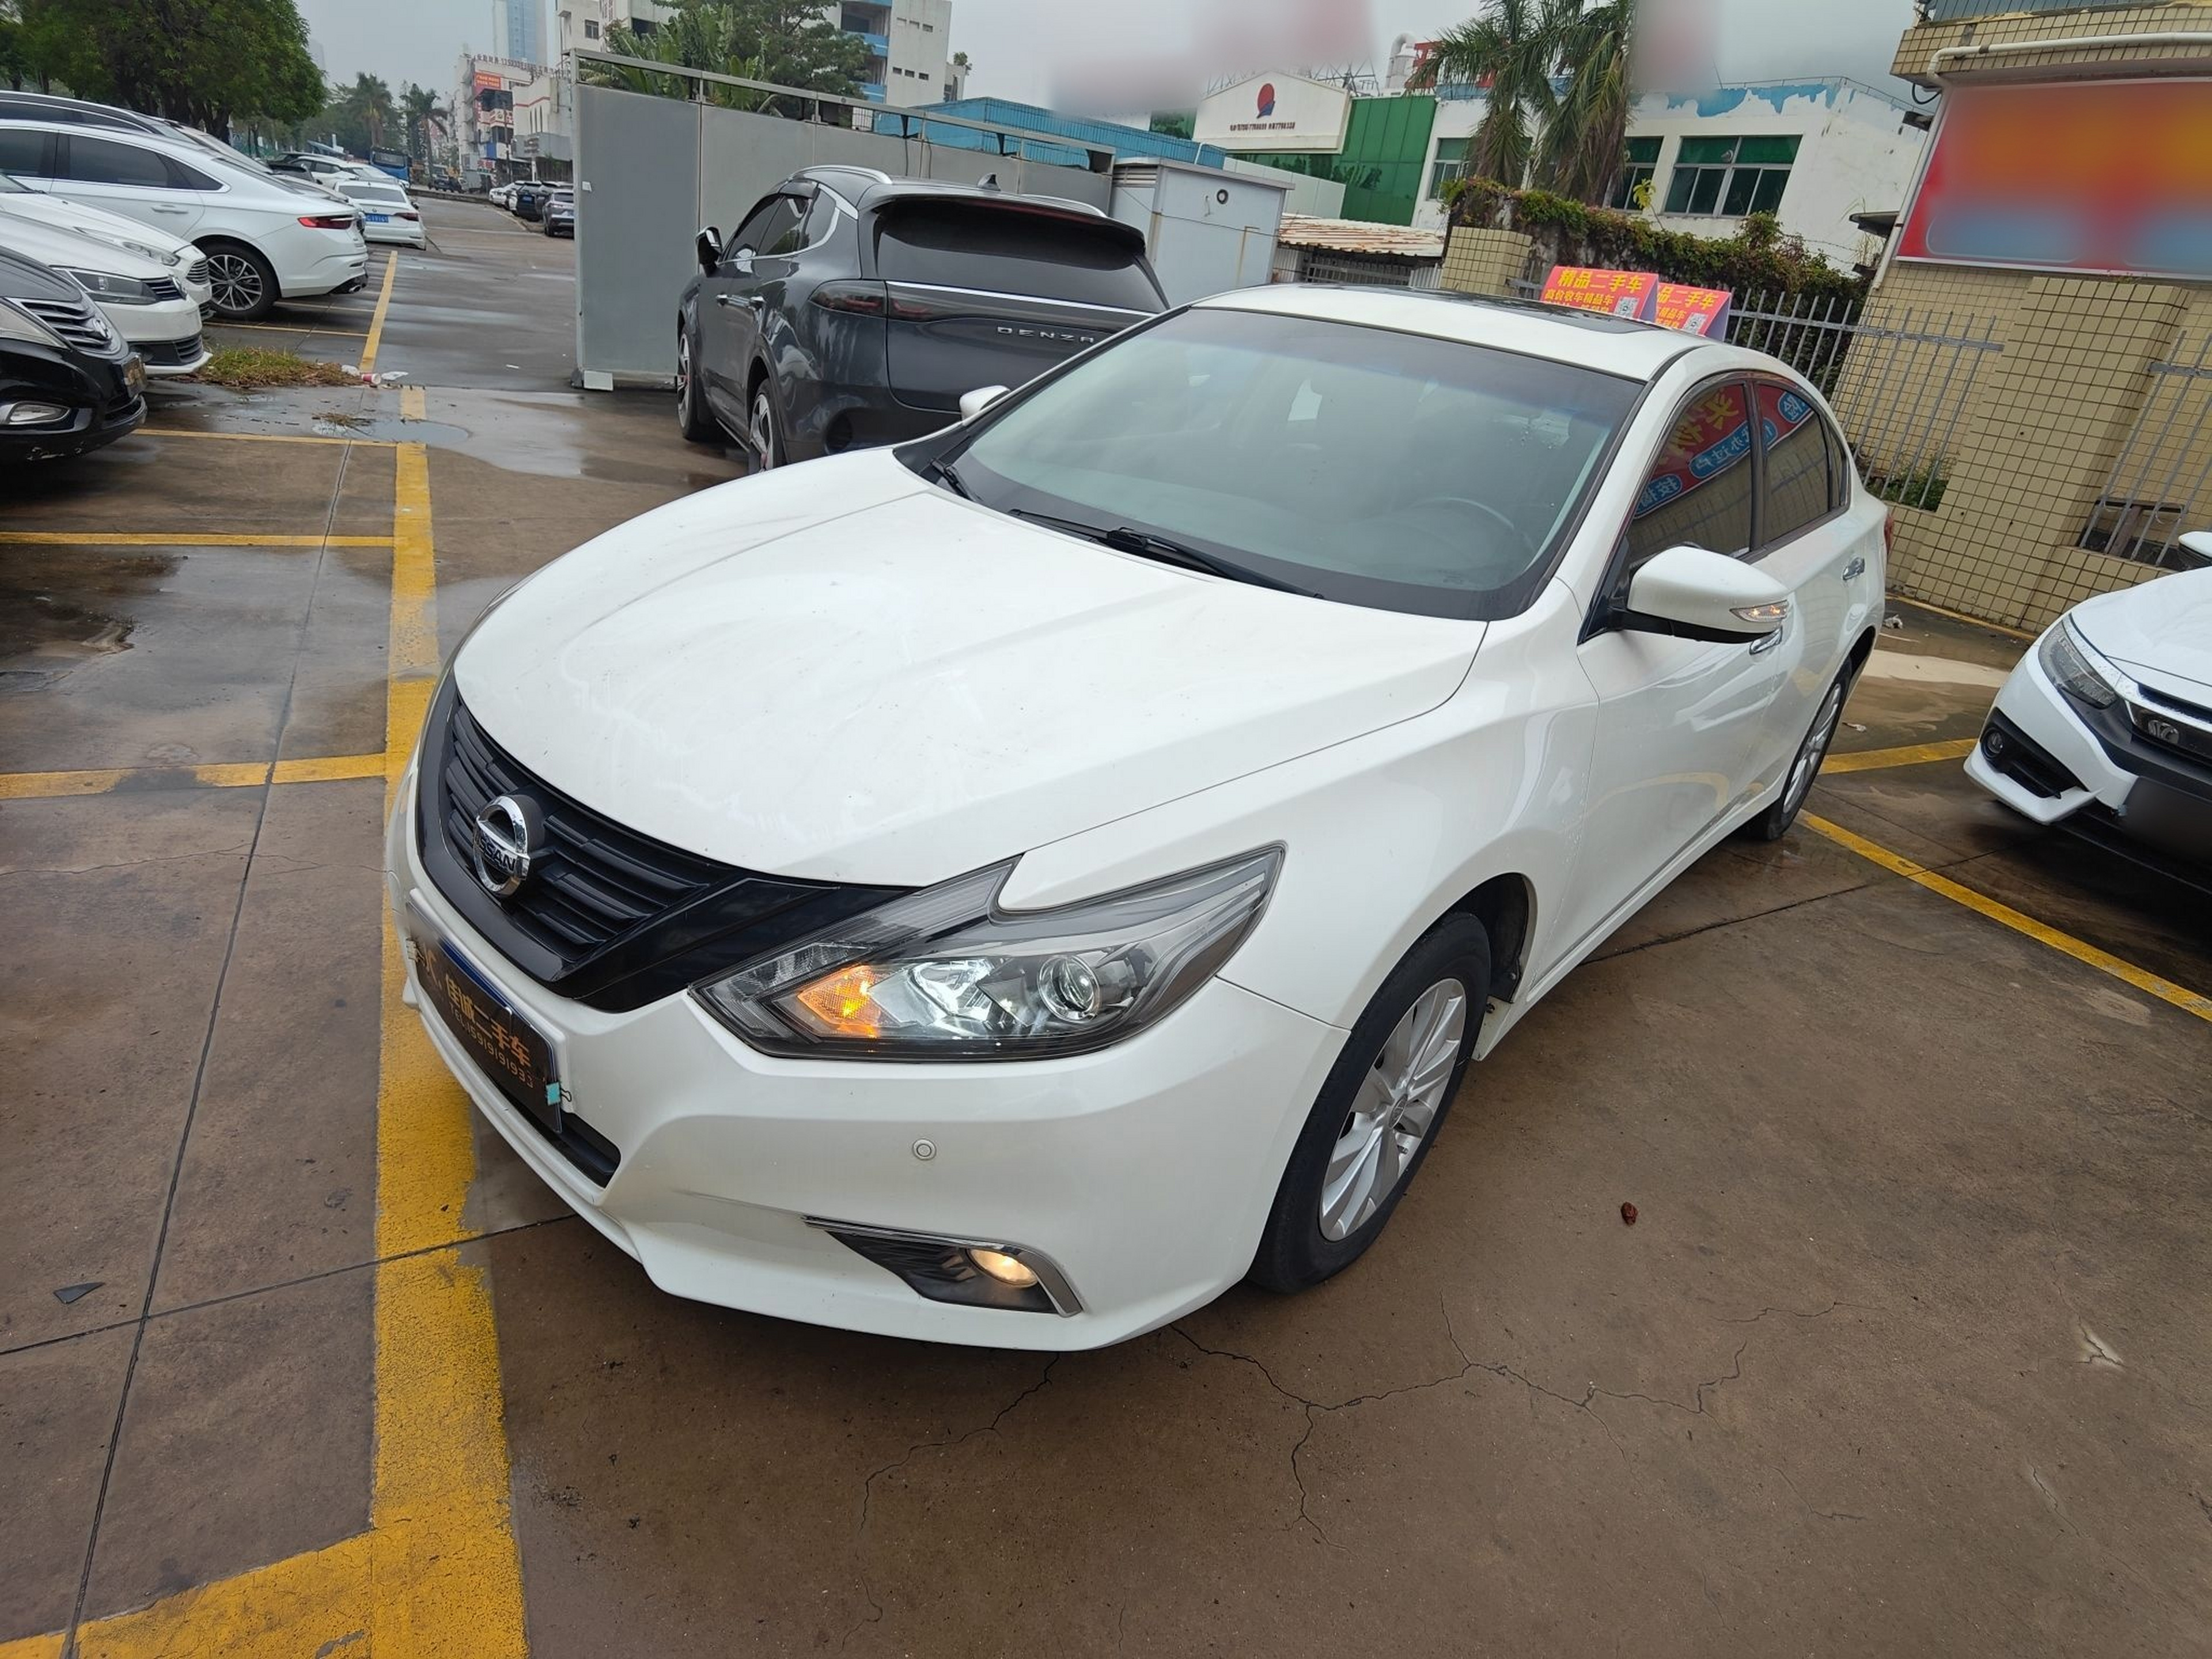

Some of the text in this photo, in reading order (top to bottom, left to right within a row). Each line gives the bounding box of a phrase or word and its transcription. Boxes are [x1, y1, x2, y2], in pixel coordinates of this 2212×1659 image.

[1557, 269, 1645, 293] 精品二手车
[1545, 289, 1615, 305] 高价收车精品车
[1656, 306, 1687, 320] 精品车
[997, 327, 1094, 343] DENZA
